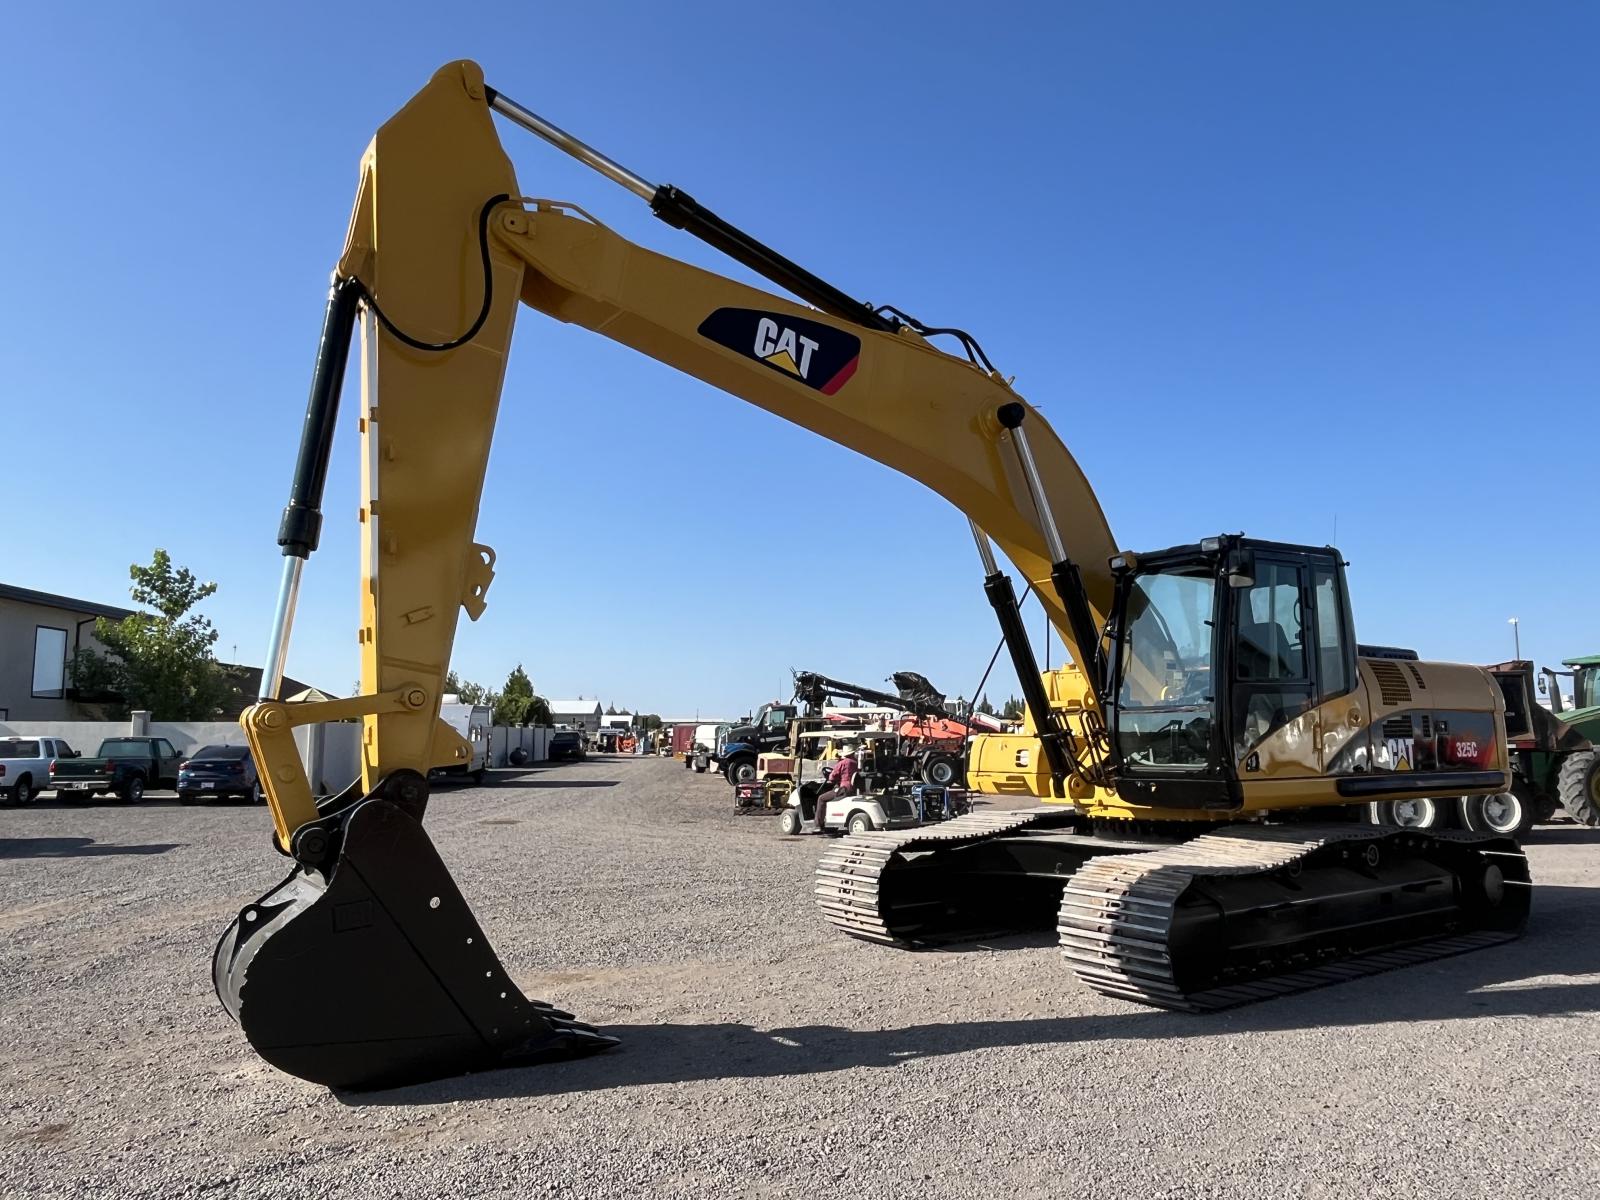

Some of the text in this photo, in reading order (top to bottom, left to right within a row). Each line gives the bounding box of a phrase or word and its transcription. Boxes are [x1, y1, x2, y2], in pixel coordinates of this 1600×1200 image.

[753, 317, 820, 379] CAT
[1387, 738, 1415, 771] CAT
[1455, 741, 1478, 758] 325C
